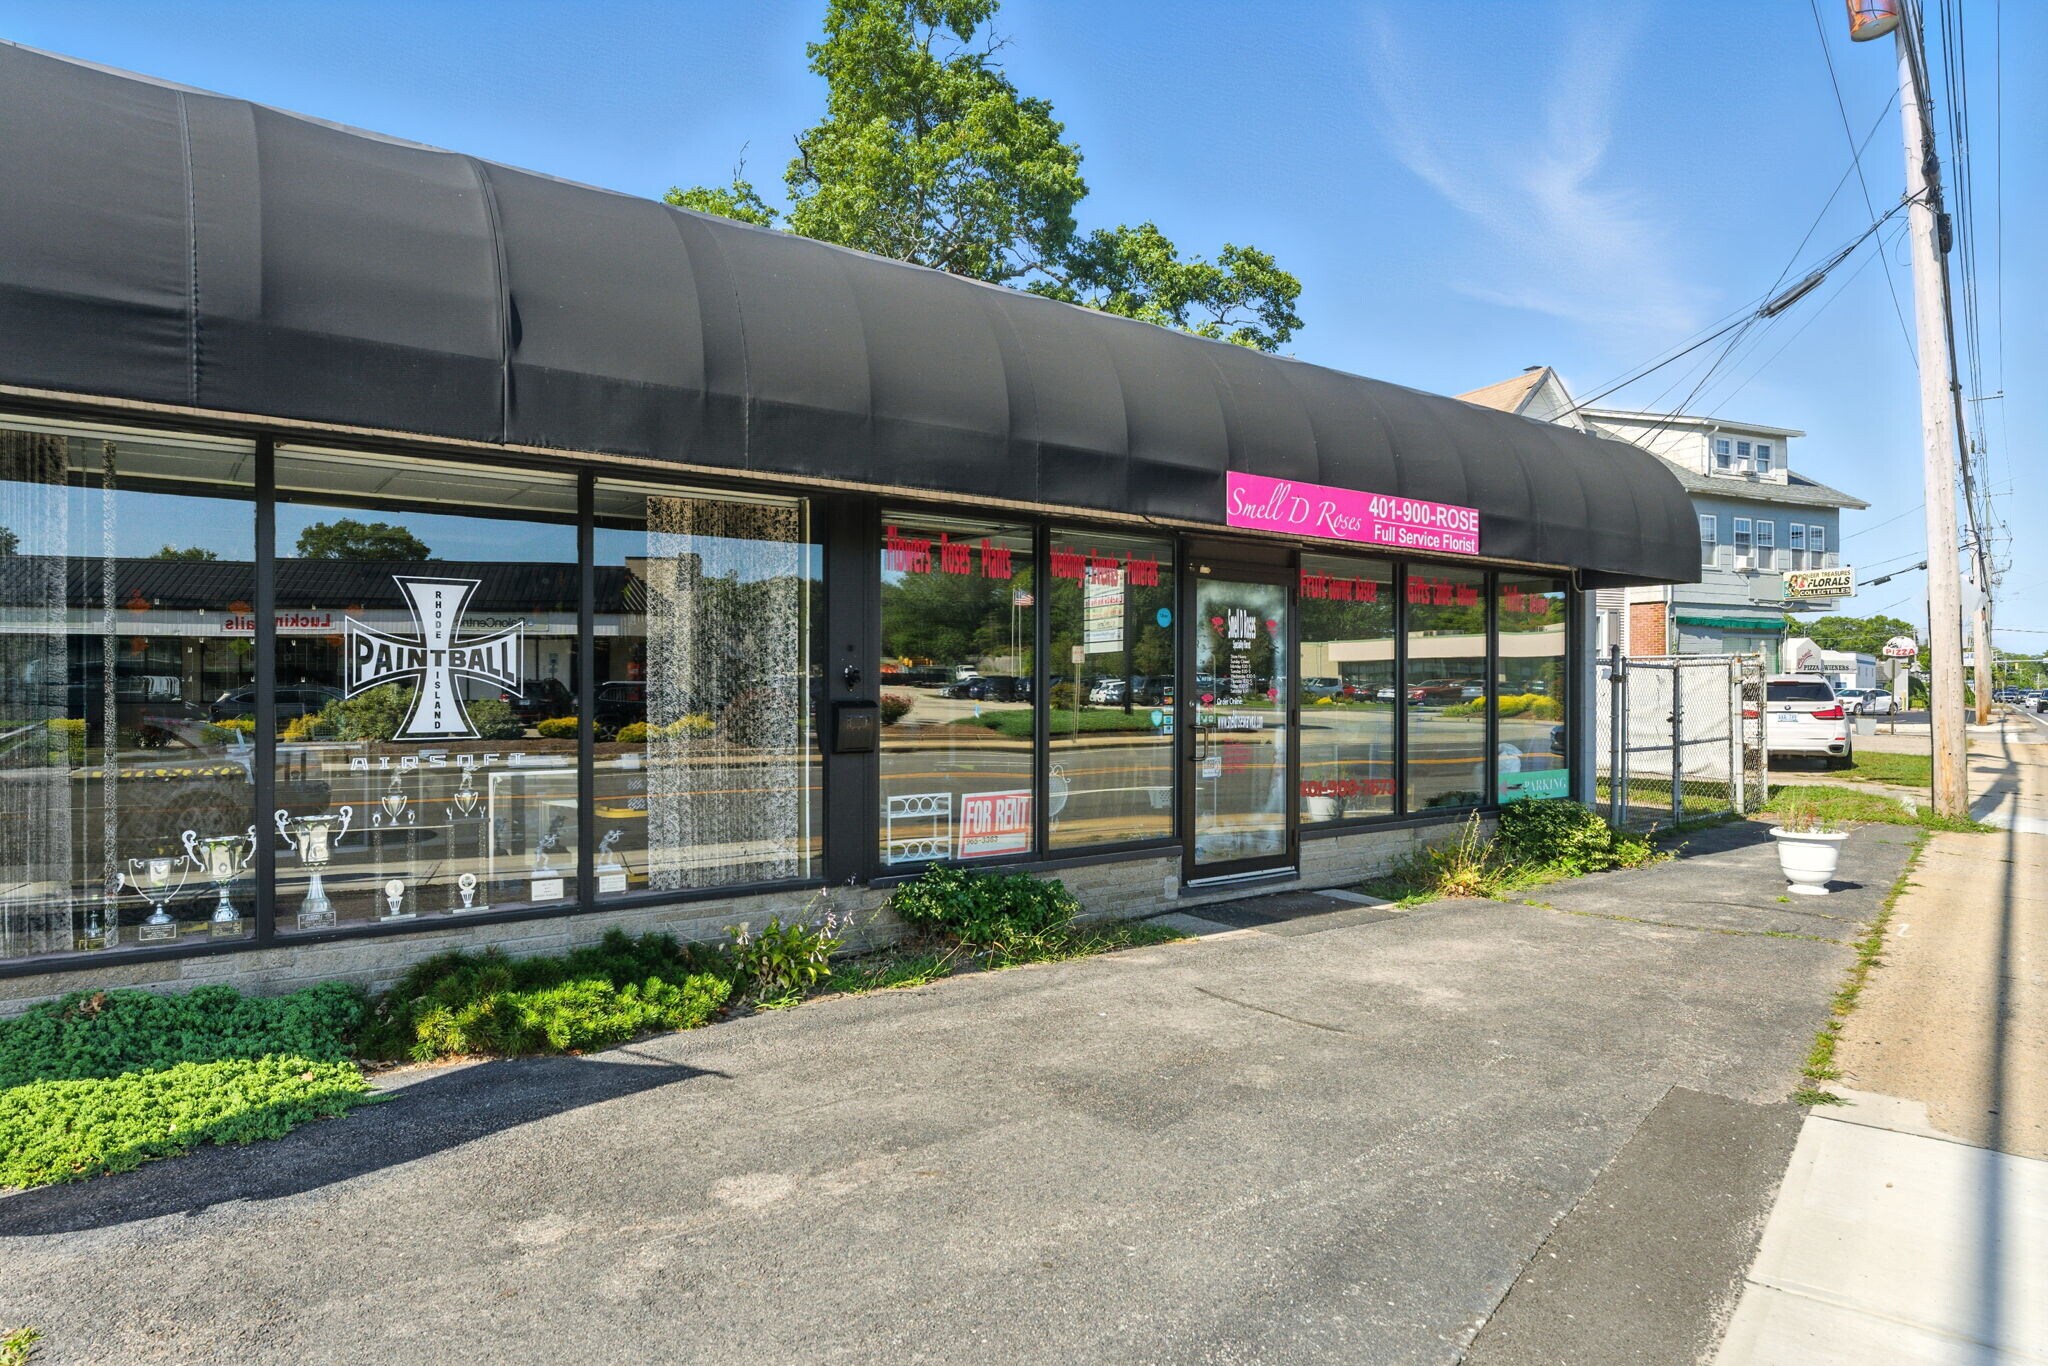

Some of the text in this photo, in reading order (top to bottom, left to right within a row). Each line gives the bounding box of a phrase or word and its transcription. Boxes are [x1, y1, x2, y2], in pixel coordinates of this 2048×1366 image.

[1227, 482, 1362, 537] Smell D Roses
[1368, 496, 1479, 532] 401-900-ROSE
[1374, 525, 1476, 553] Full Service Florist
[886, 525, 1012, 580] Flowers Roses Plants
[1807, 576, 1851, 588] FLORALS
[1821, 569, 1851, 578] TREASURES
[1800, 587, 1851, 596] COLLECTIBLES
[355, 631, 515, 684] PAINTBALL
[1885, 648, 1915, 656] PIZZA
[1216, 698, 1229, 706] Order
[351, 752, 526, 771] AIRSOFT
[1524, 776, 1567, 792] PARKING
[965, 796, 1029, 836] FOR RENT
